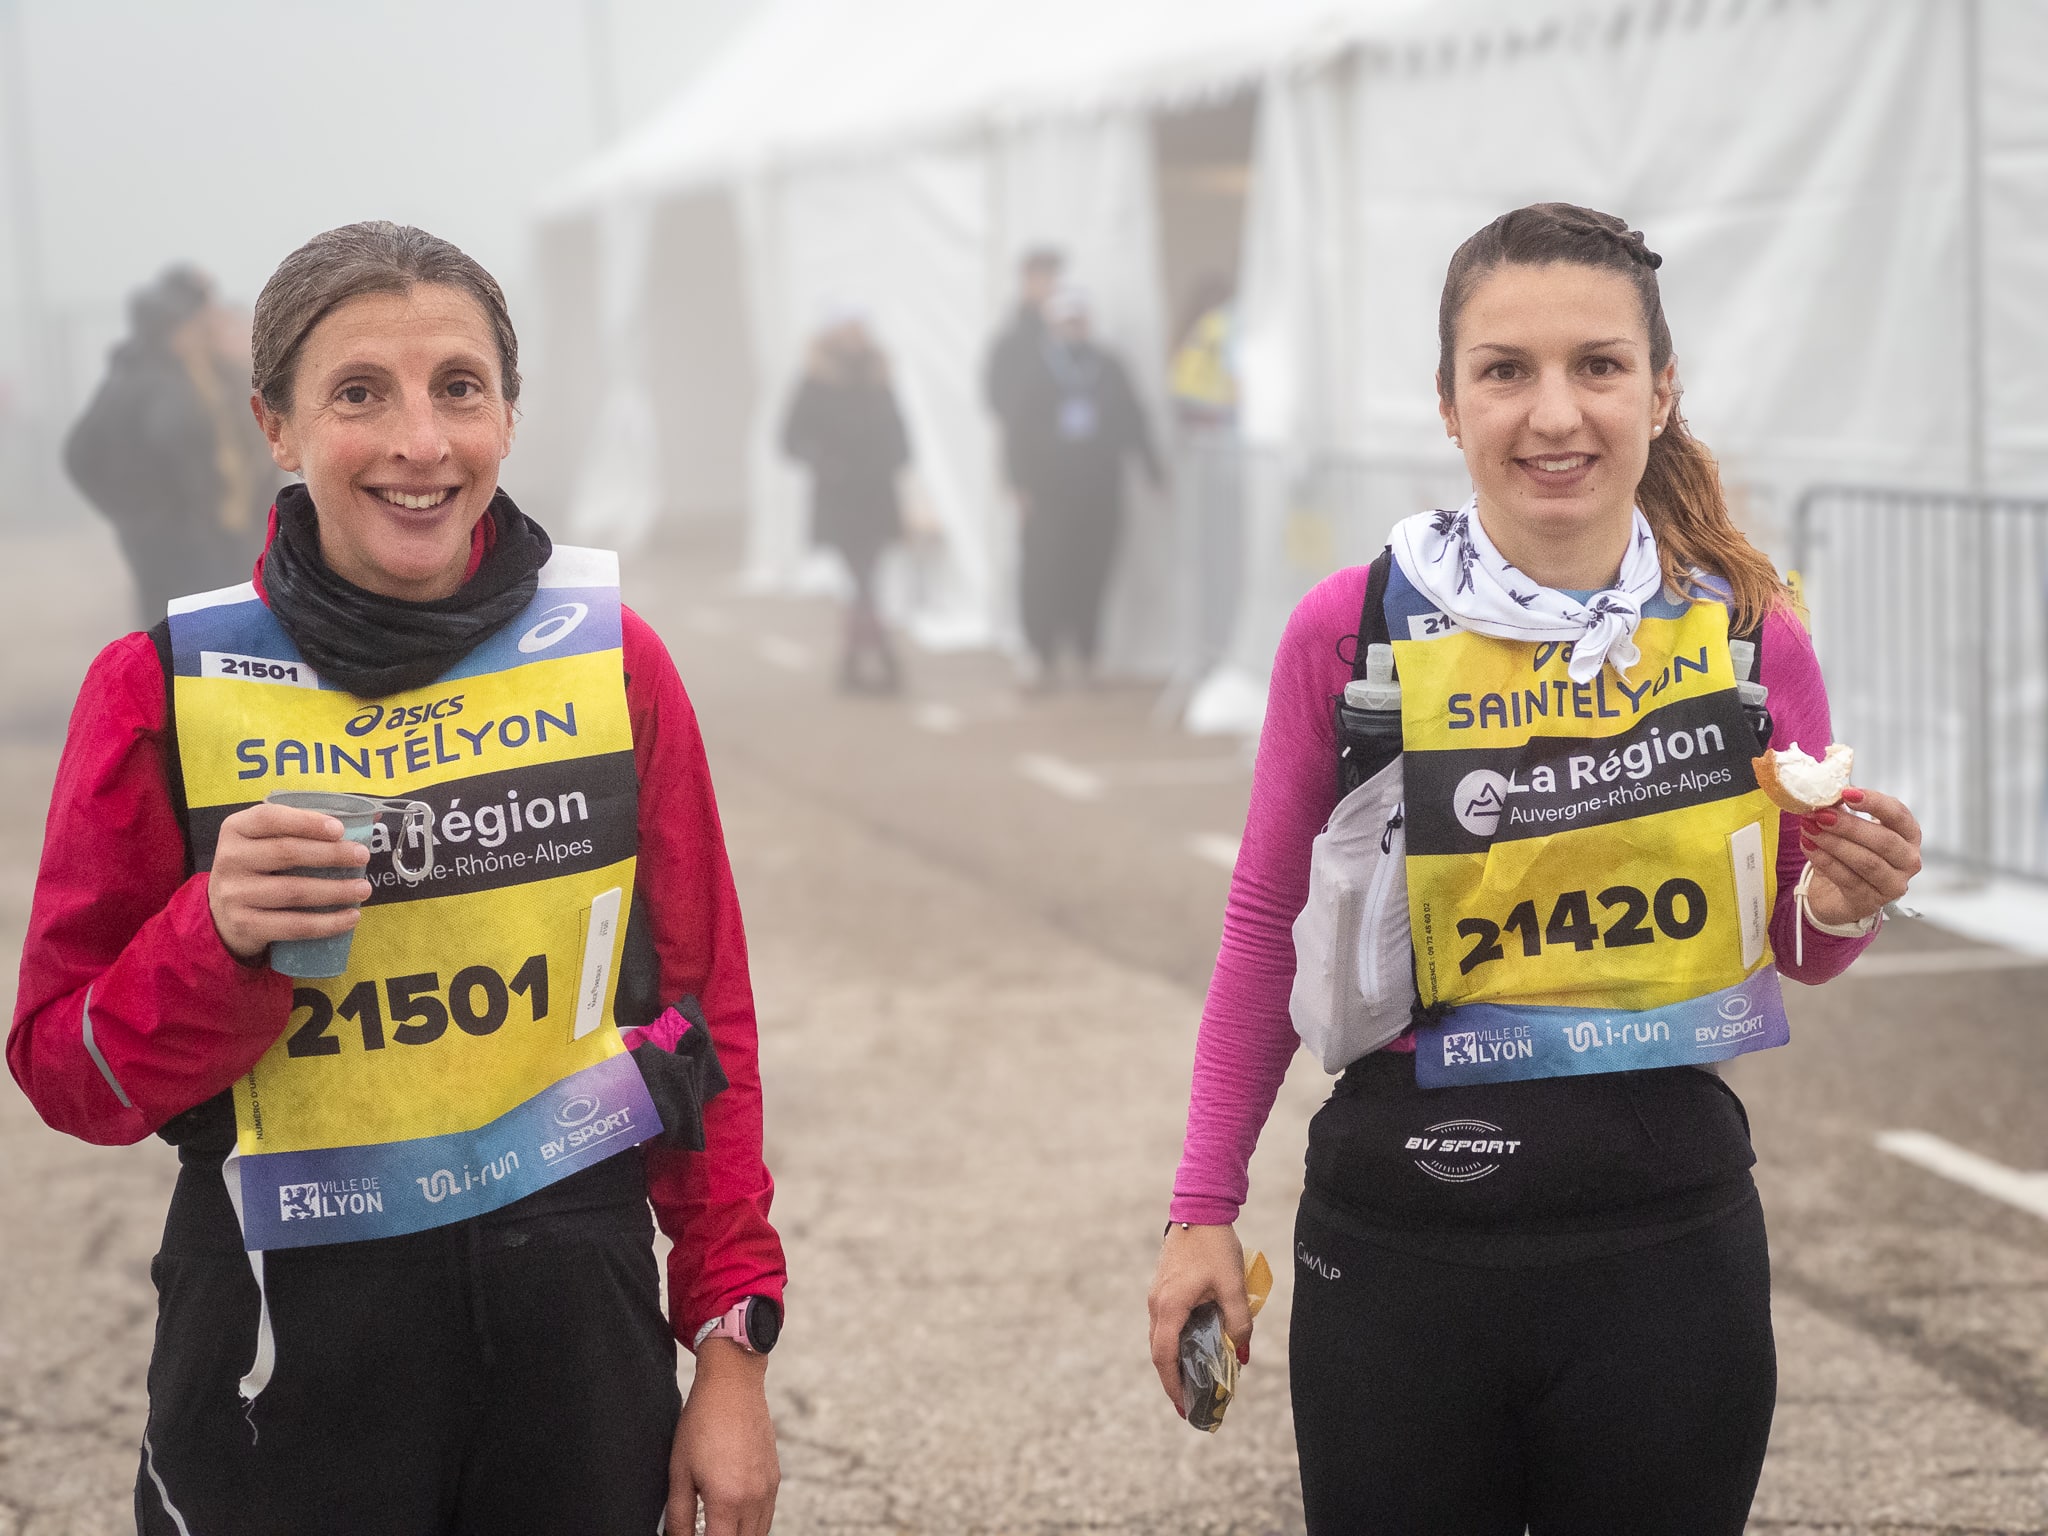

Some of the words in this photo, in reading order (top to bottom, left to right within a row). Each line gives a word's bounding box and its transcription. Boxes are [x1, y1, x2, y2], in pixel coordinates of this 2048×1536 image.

[221, 657, 299, 683] 21501
[237, 702, 578, 780] SAINTÉLYON
[1507, 767, 1557, 795] La
[1568, 723, 1725, 791] Région
[1509, 766, 1732, 826] Auvergne-Rhône-Alpes
[370, 822, 392, 854] a
[407, 789, 589, 850] Région
[1455, 877, 1708, 976] 21420
[286, 954, 549, 1058] 21501
[1476, 1027, 1511, 1043] VILLE
[1514, 1025, 1531, 1038] DE
[1605, 1019, 1670, 1045] i-run
[1695, 1026, 1720, 1042] BV
[1721, 1014, 1764, 1039] SPORT
[1478, 1038, 1534, 1063] LYON
[540, 1136, 565, 1160] BV
[568, 1107, 630, 1147] SPORT
[1405, 1137, 1438, 1151] BV
[1439, 1139, 1521, 1154] SPORT
[319, 1178, 357, 1194] VILLE
[362, 1176, 381, 1191] DE
[463, 1150, 519, 1190] i-run
[322, 1191, 384, 1217] LYON
